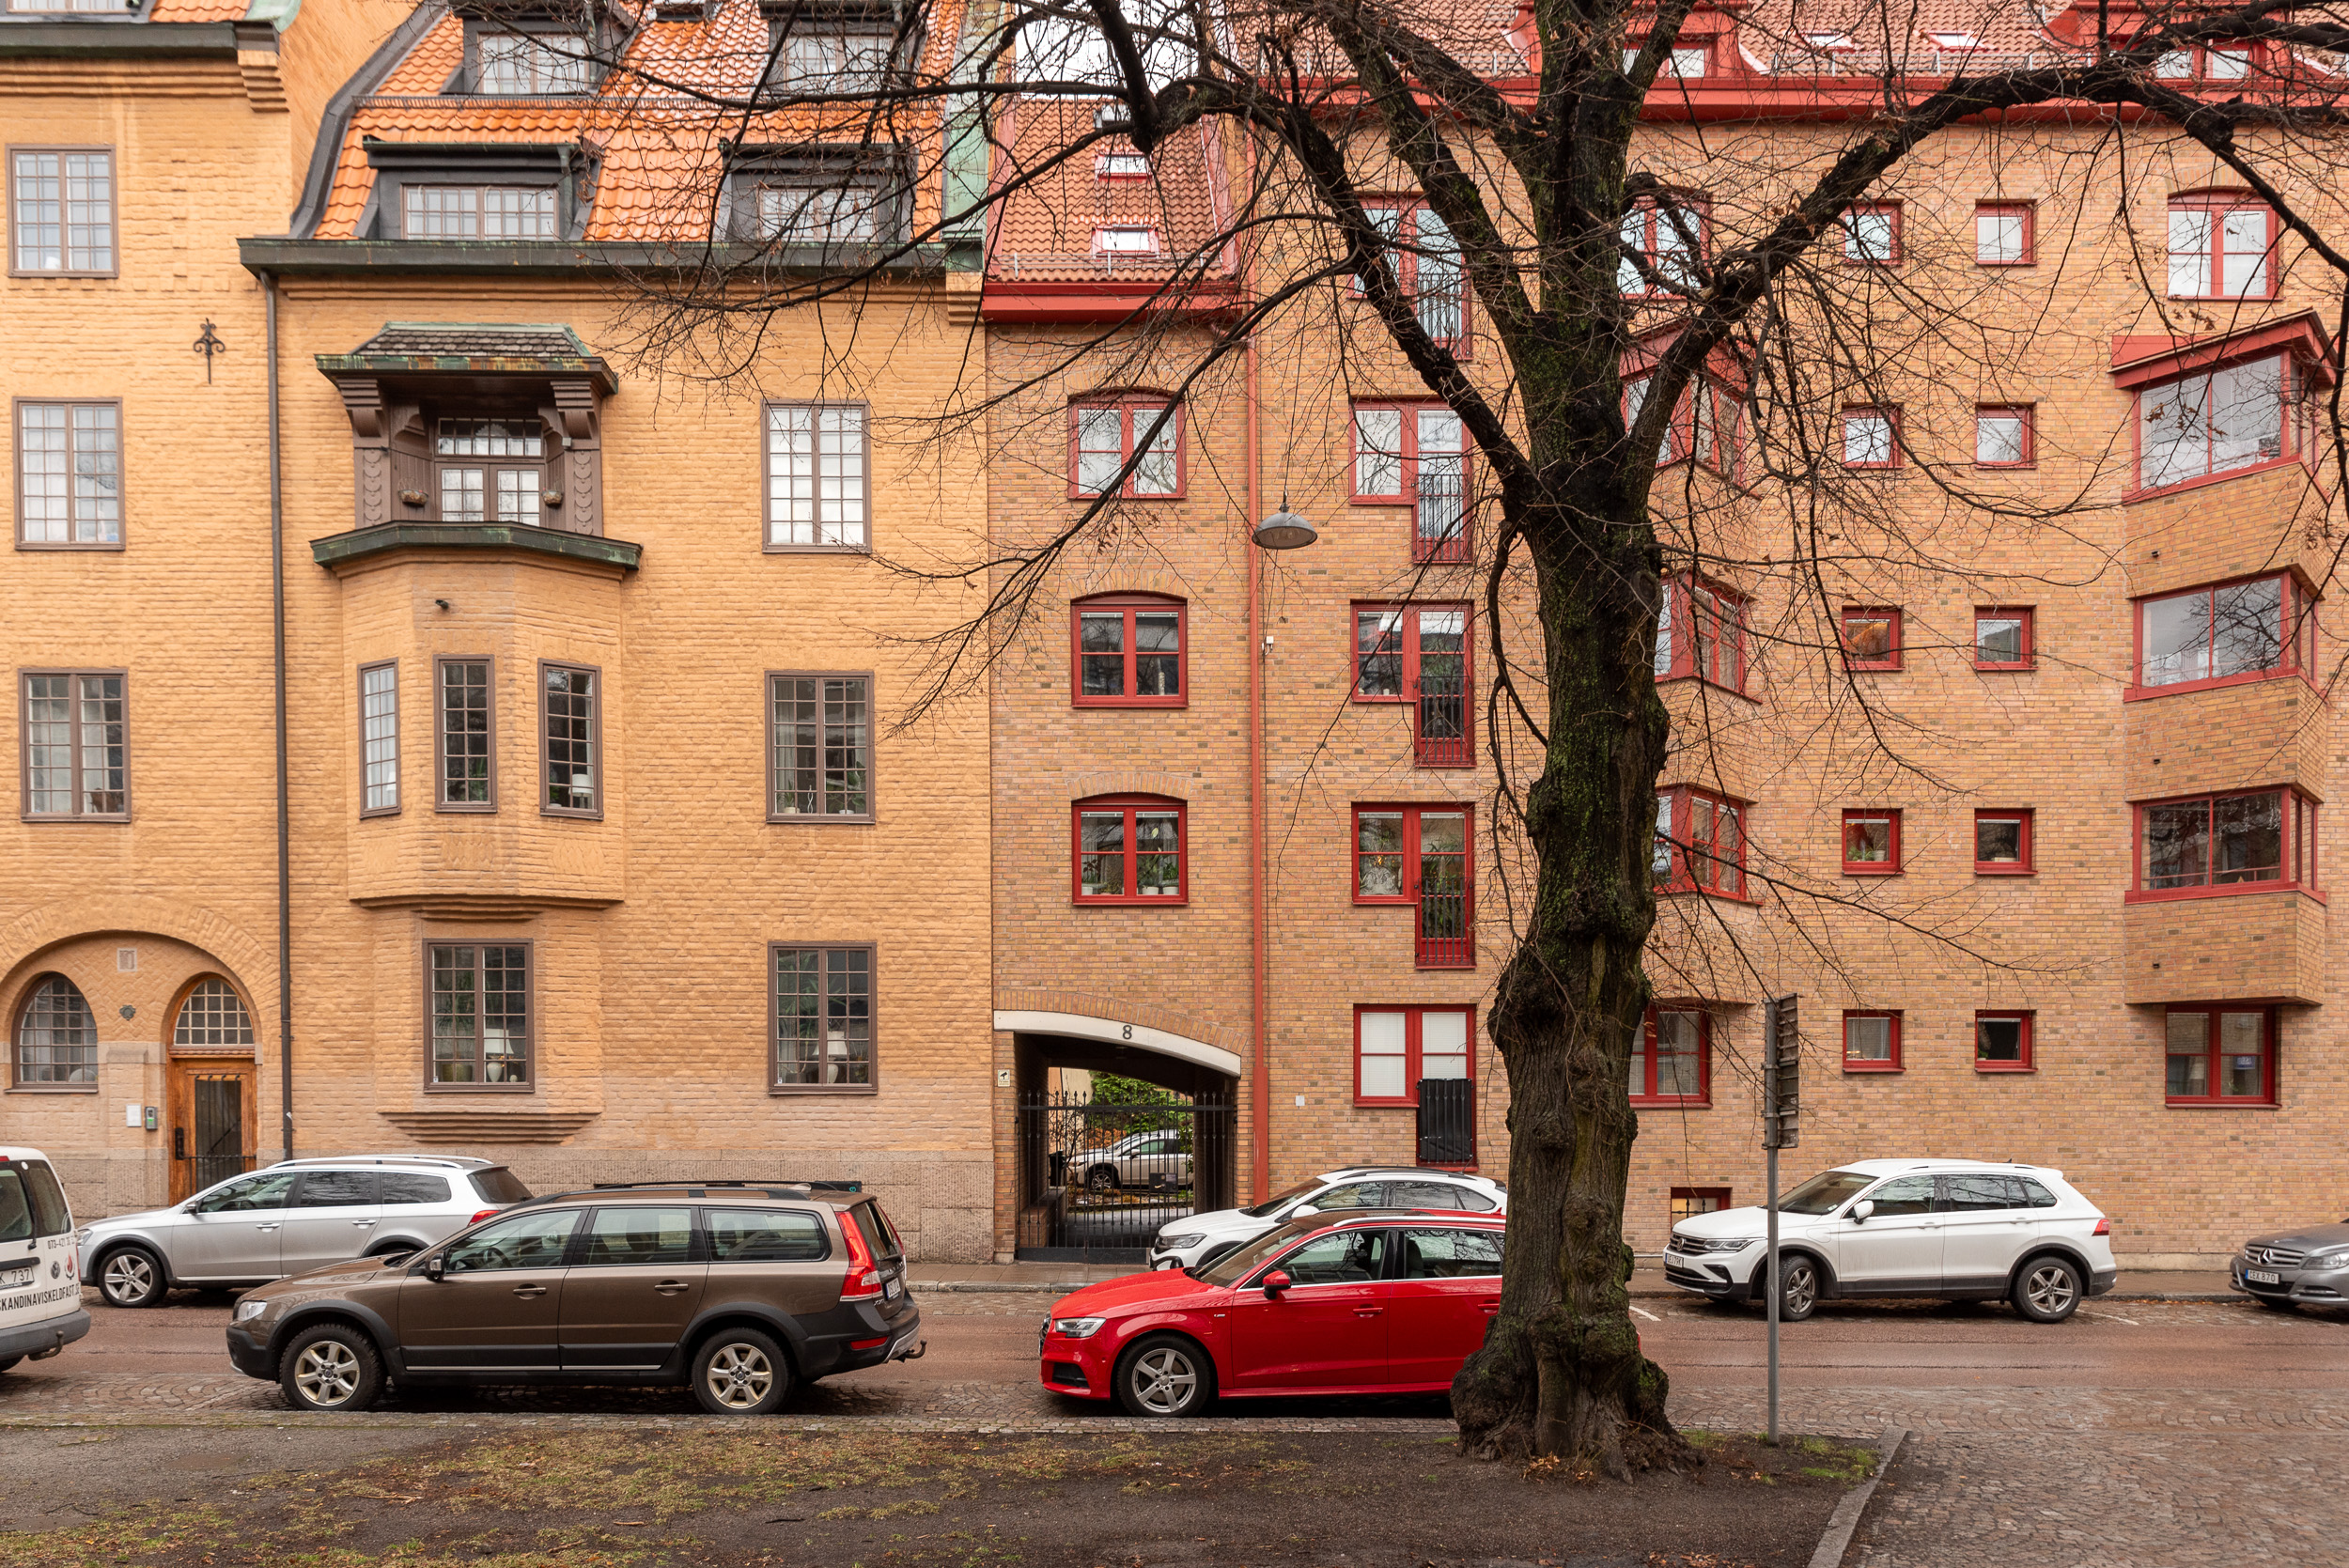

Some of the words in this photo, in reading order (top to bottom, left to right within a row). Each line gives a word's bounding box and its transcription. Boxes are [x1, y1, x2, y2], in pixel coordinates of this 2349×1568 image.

[1122, 1024, 1132, 1040] 8
[11, 1269, 29, 1282] 737
[2261, 1272, 2276, 1282] 870
